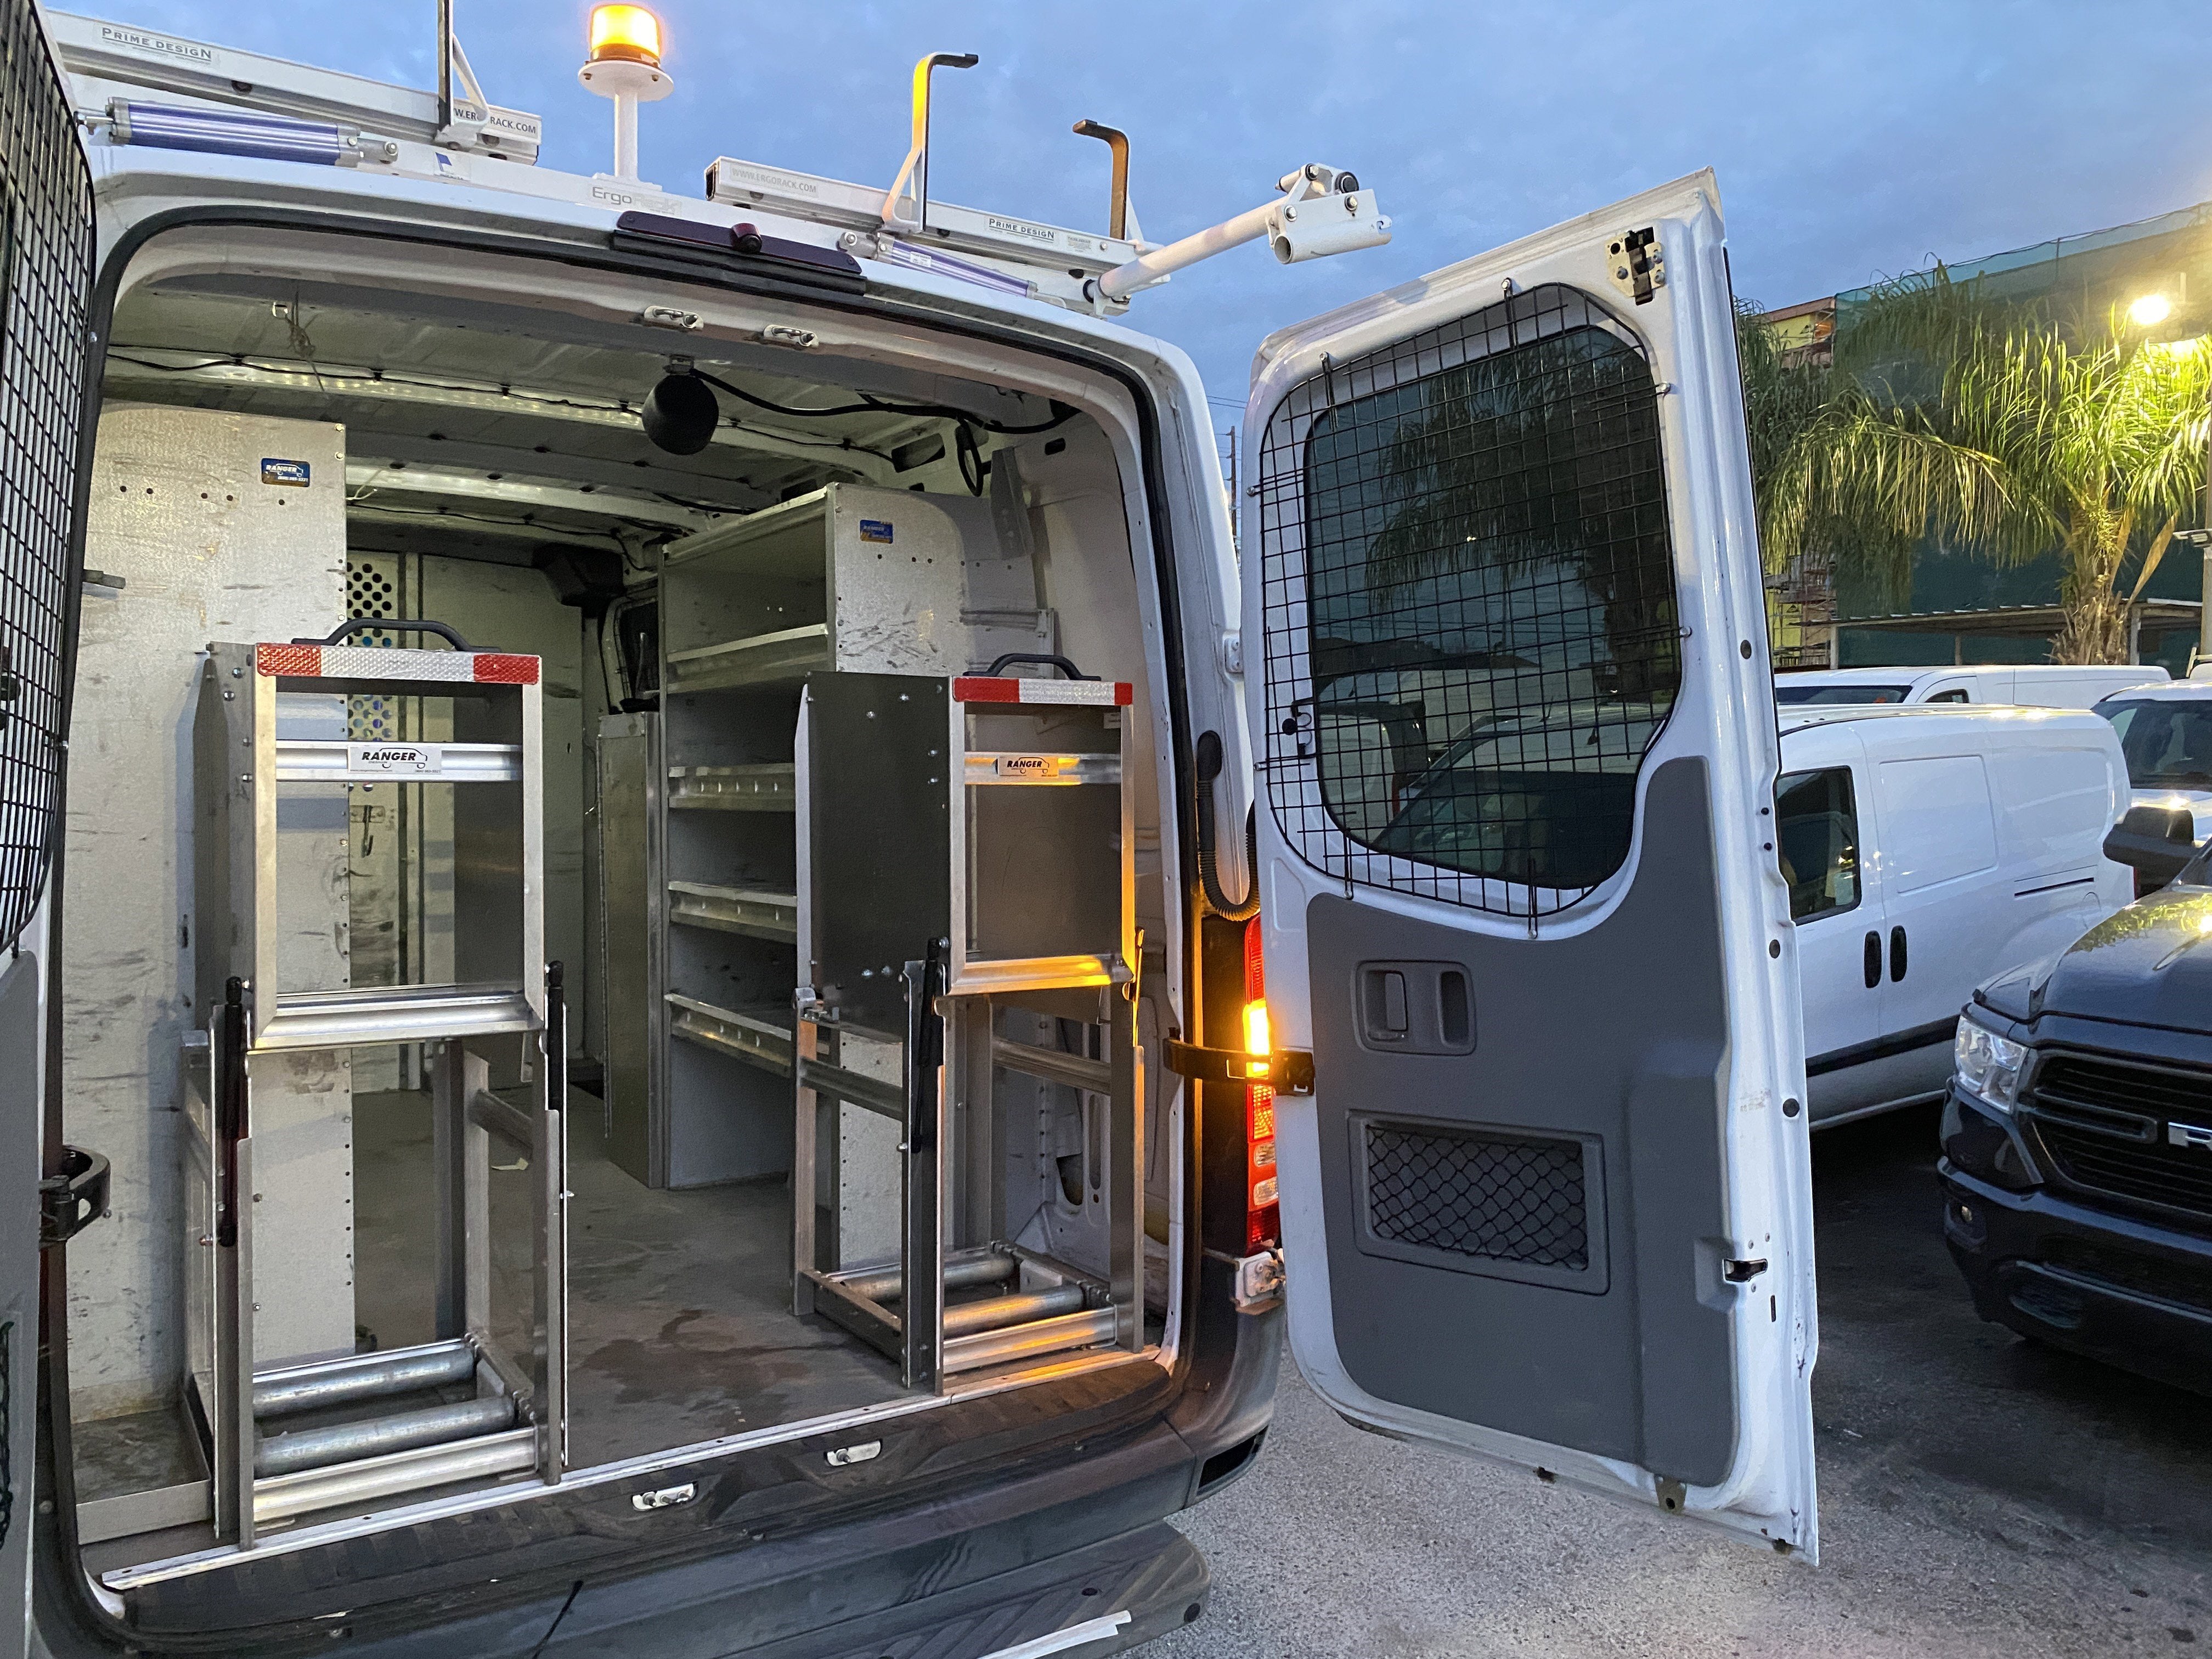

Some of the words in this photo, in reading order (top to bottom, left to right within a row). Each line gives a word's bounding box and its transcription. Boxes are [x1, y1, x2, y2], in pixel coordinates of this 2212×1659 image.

[102, 27, 150, 46] PRIME
[156, 41, 211, 59] DESIGN
[454, 108, 536, 134] W.ERRACK.COM
[731, 167, 817, 193] WWW.ERGORACK.COM
[989, 218, 1018, 231] PRIME
[1020, 226, 1054, 239] DESIGN
[266, 464, 297, 472] RANGER
[362, 752, 416, 761] RANGER
